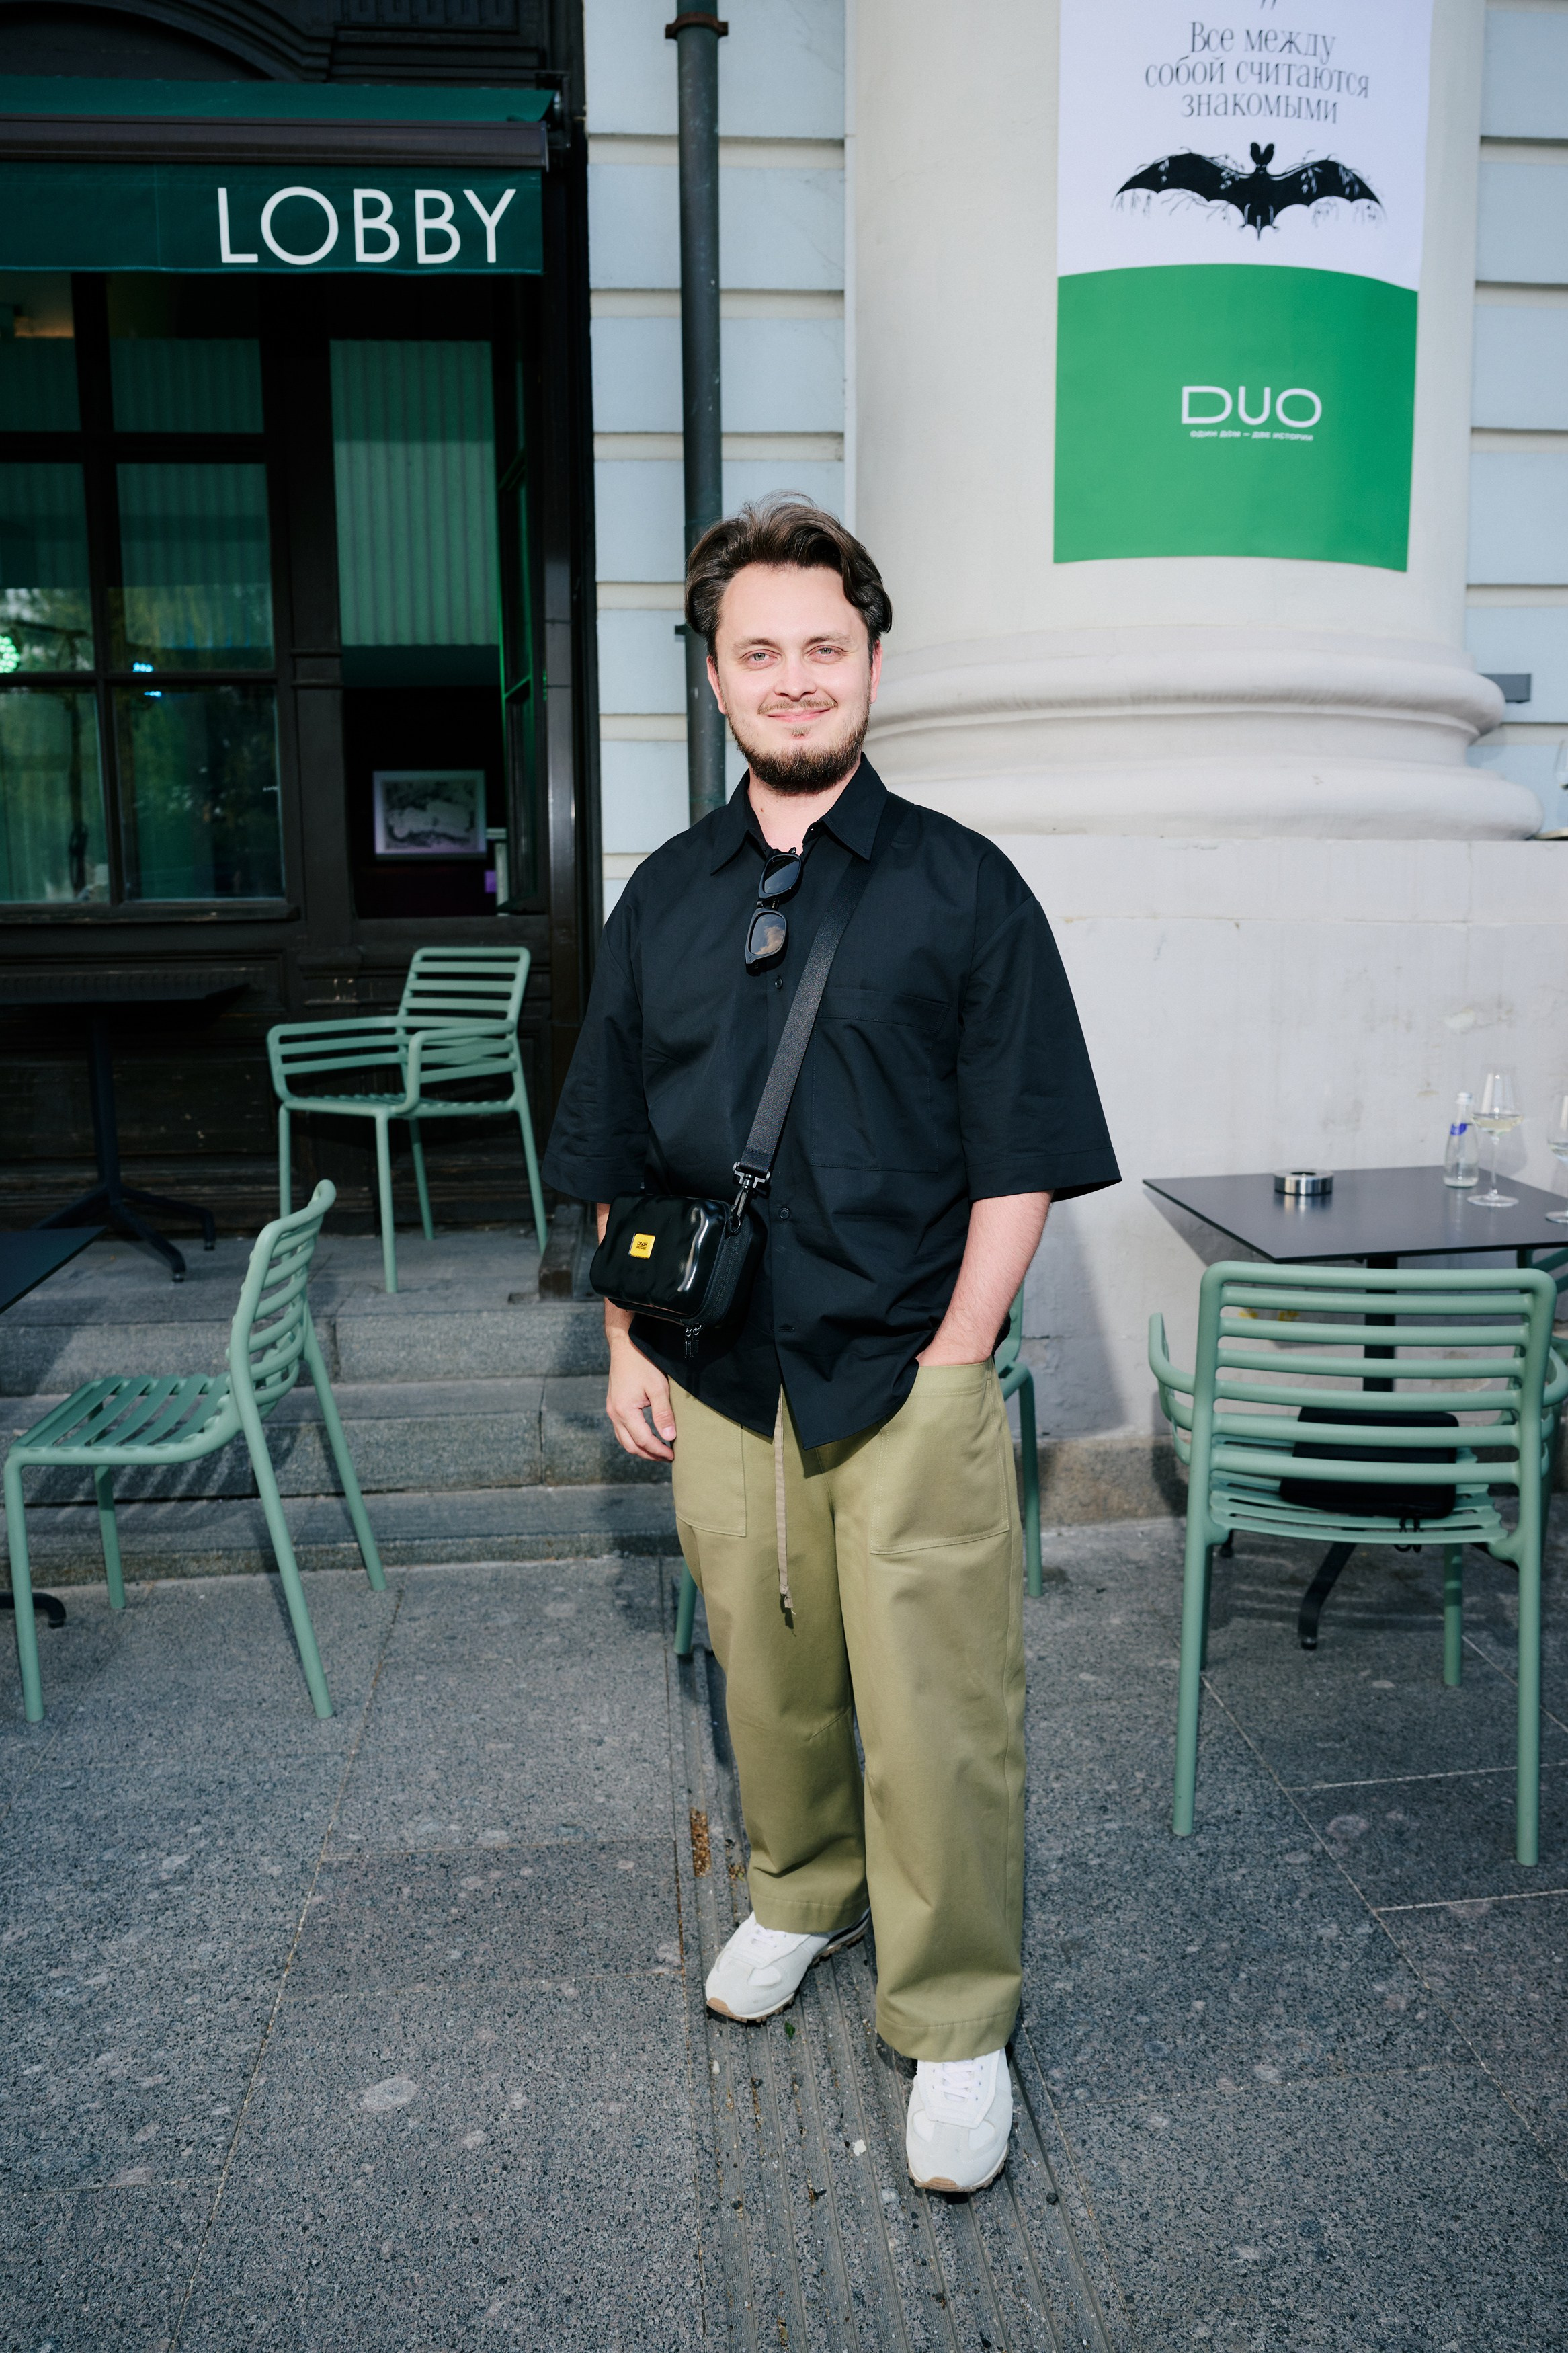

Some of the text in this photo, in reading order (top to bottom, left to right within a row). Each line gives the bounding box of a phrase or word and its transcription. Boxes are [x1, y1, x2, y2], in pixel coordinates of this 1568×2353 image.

[1190, 22, 1336, 65] Все между
[1145, 56, 1369, 99] собой считаются
[1181, 93, 1337, 124] знакомыми
[218, 186, 516, 265] LOBBY
[1182, 386, 1322, 428] DUO
